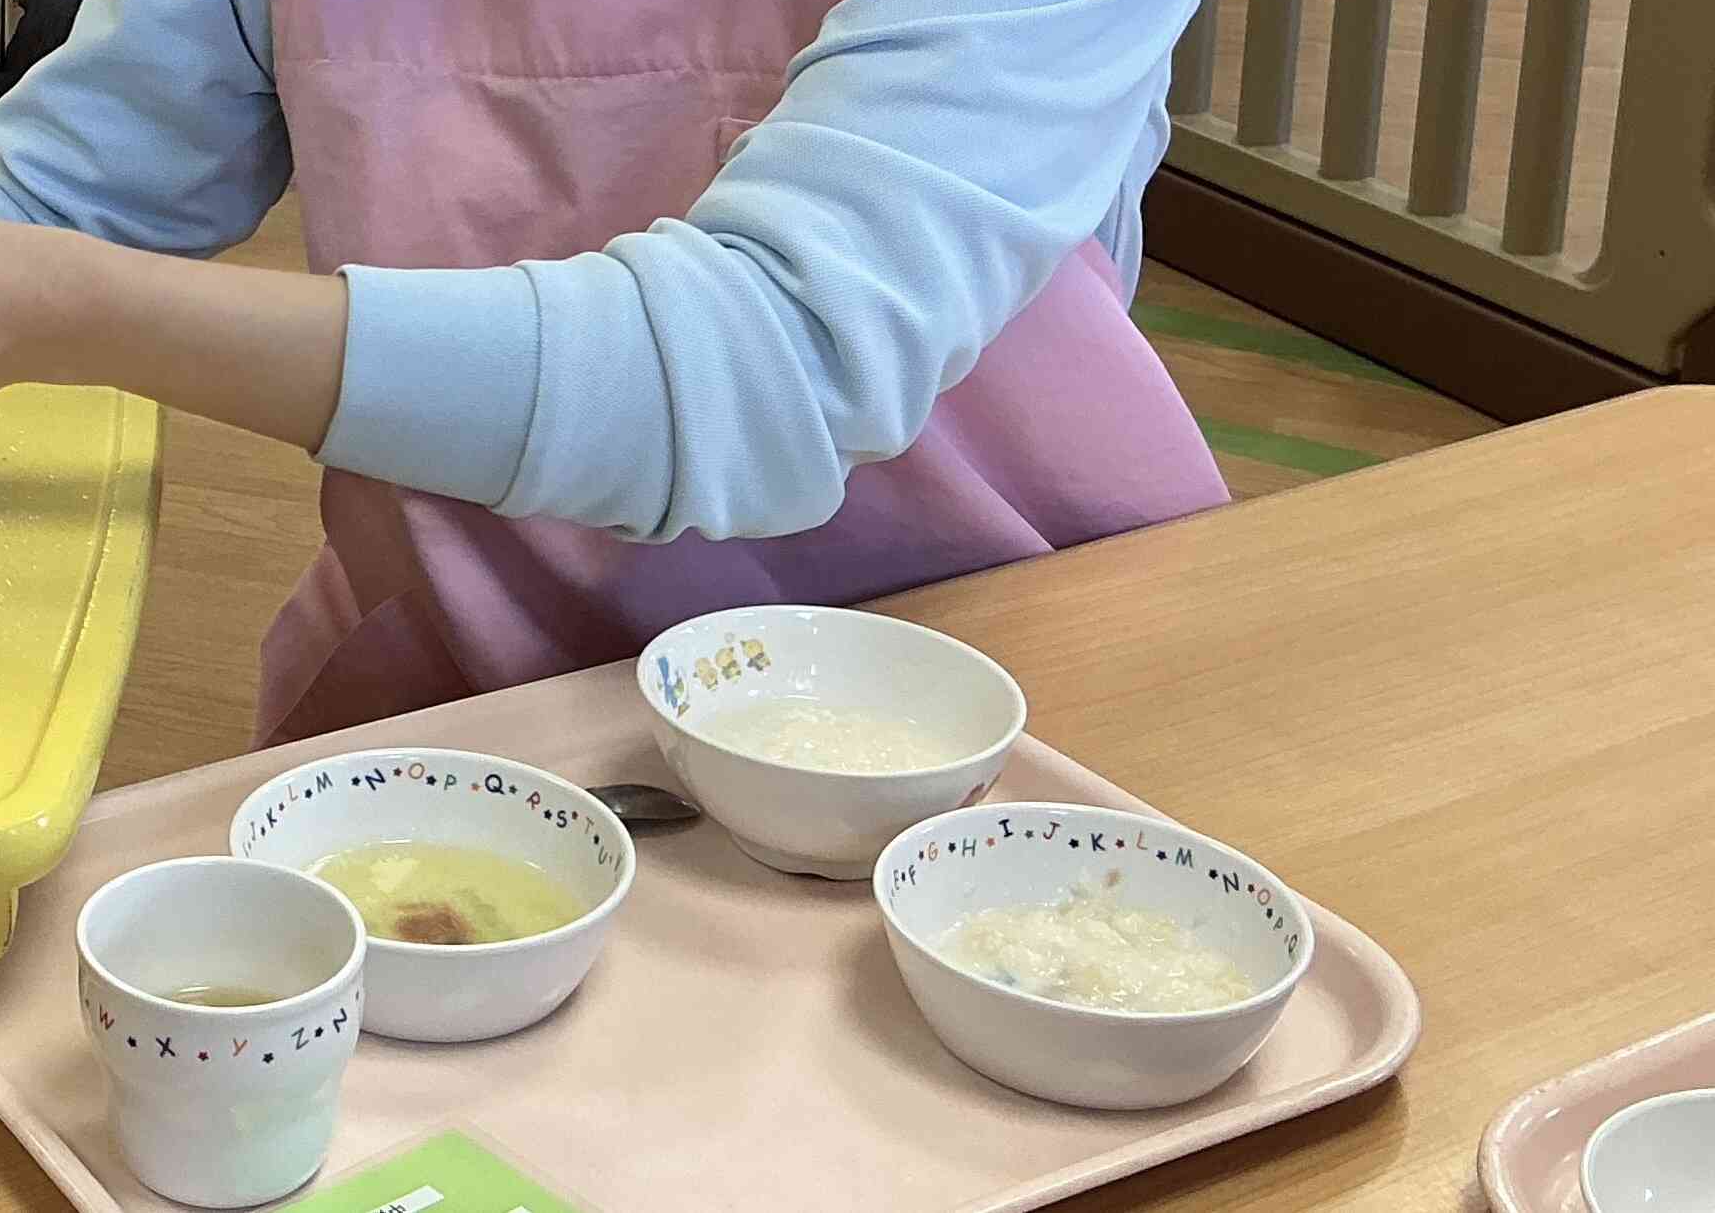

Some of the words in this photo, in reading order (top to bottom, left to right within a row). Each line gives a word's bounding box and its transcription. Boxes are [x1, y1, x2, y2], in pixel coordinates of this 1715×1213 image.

[266, 807, 278, 829] K
[287, 784, 299, 802] L
[315, 771, 334, 793] M
[364, 767, 387, 791] N
[408, 762, 425, 780] O
[444, 774, 457, 791] P
[484, 773, 506, 796] Q
[556, 810, 568, 828] S
[908, 864, 917, 886] F
[961, 837, 977, 858] H
[998, 818, 1014, 838] I
[1042, 820, 1061, 841] J
[1090, 832, 1106, 852] K
[1136, 830, 1148, 851] L
[1175, 846, 1194, 869] M
[1222, 872, 1241, 894] N
[1256, 888, 1272, 907] O
[155, 1036, 176, 1058] X
[291, 1026, 309, 1051] Z
